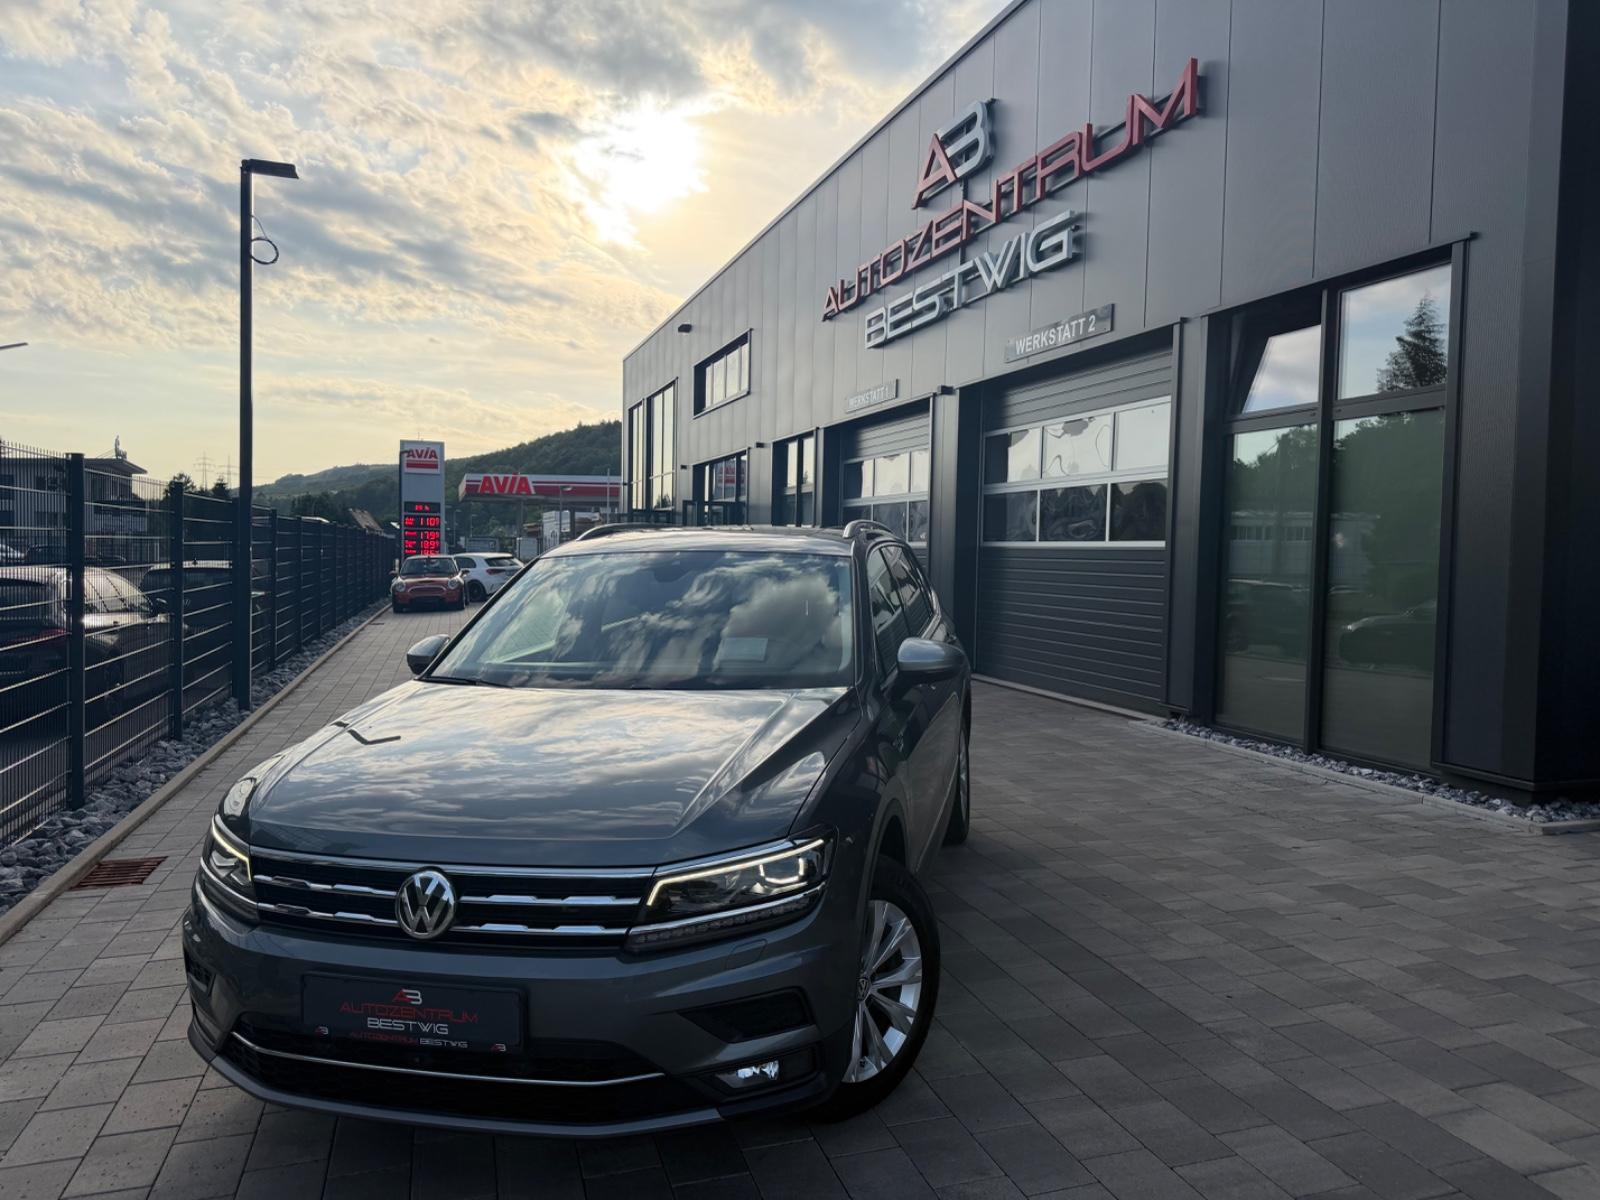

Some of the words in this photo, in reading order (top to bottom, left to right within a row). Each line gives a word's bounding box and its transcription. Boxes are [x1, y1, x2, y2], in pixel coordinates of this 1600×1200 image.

[822, 57, 1199, 322] AUTOZENTRUM
[865, 210, 1080, 349] BESTWIG
[1015, 317, 1086, 355] WERKSTATT
[1087, 314, 1096, 333] 2
[406, 447, 439, 460] AVIA
[479, 472, 535, 494] AVIA
[339, 1002, 479, 1024] AUTOZENTRUM
[367, 1017, 449, 1035] BESTWIG
